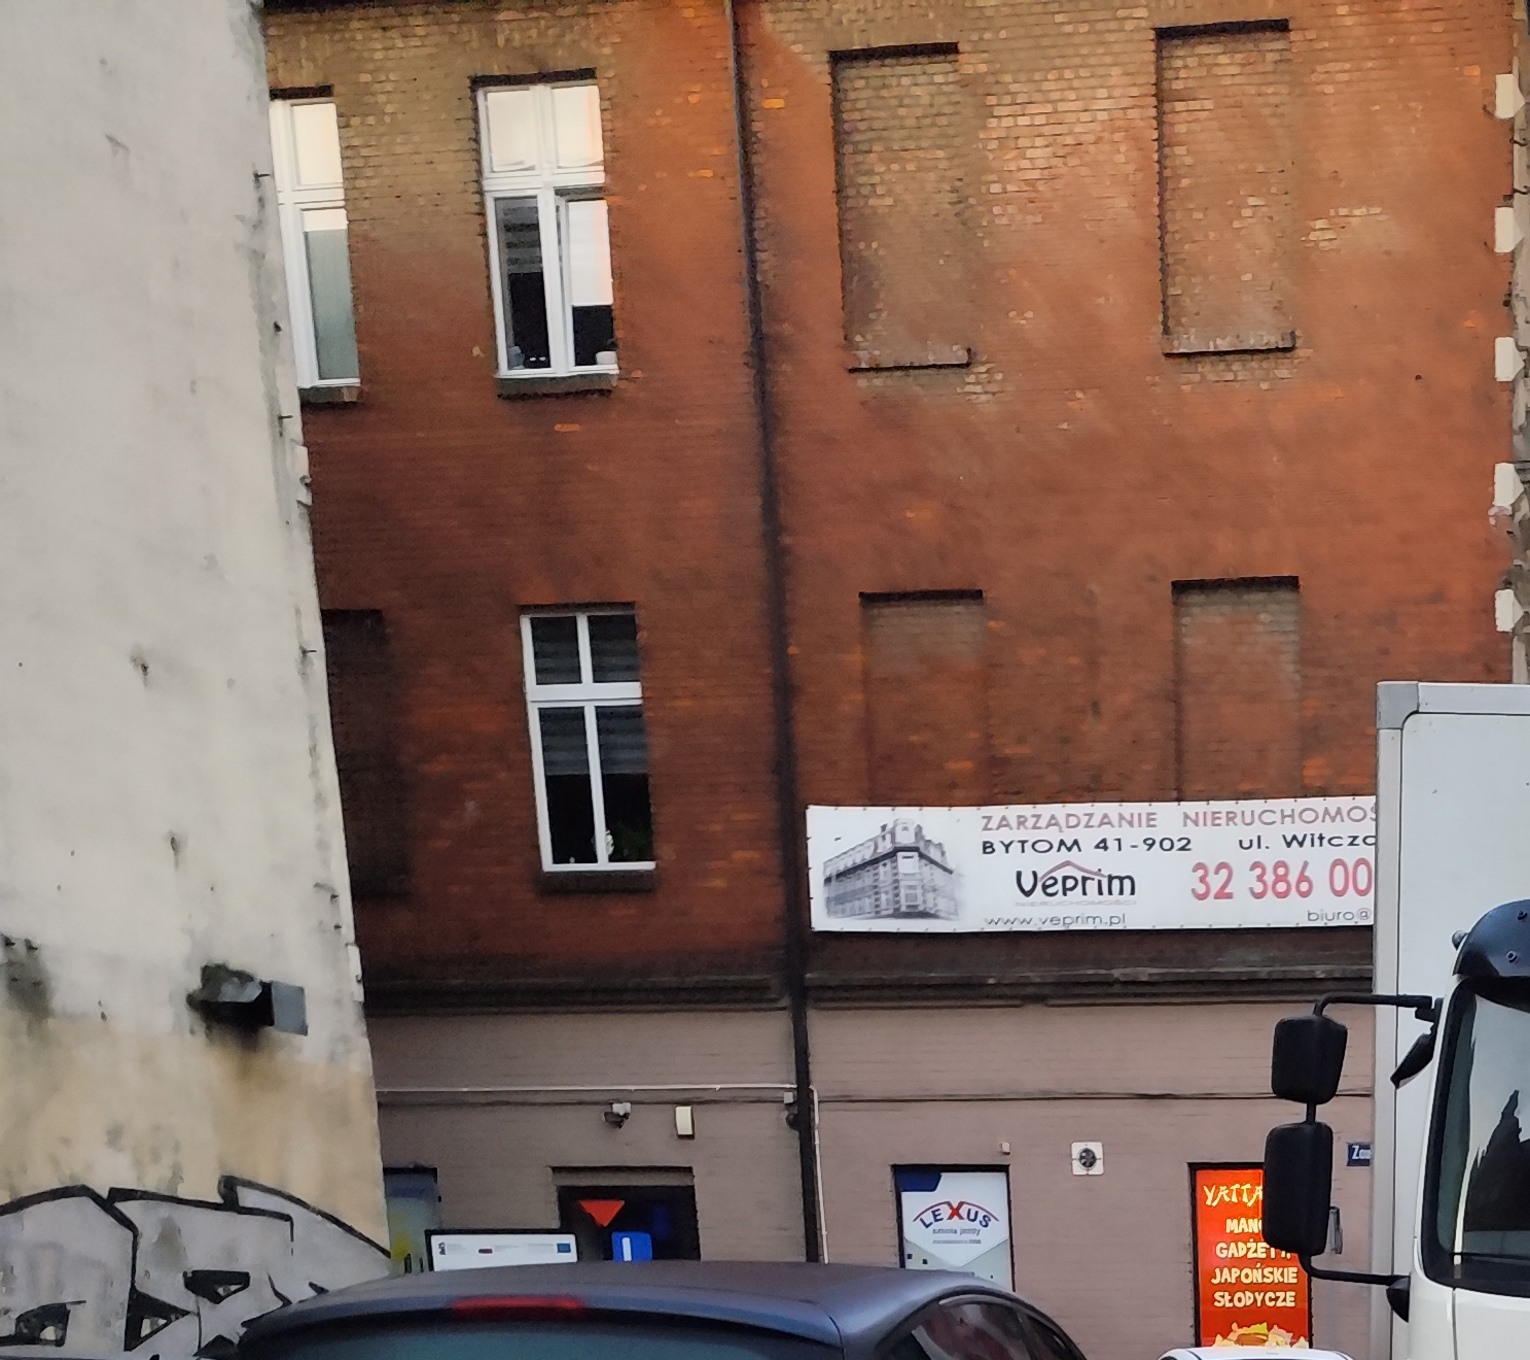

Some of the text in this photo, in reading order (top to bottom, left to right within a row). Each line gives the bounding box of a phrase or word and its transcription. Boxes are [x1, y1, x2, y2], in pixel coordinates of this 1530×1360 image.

[981, 811, 1158, 833] ZARZĄDZANIE
[981, 838, 1082, 855] BYTOM
[1094, 836, 1192, 852] 41-902
[1238, 835, 1270, 850] ul.
[1015, 868, 1136, 898] Veprim
[1190, 857, 1373, 901] 32 386 00
[984, 912, 1126, 927] www.veprim.pl
[1306, 907, 1372, 922] biuro@
[919, 1200, 992, 1229] LEXUS
[1210, 1262, 1299, 1285] JAPOŃSKIE
[1213, 1290, 1297, 1308] SŁODYCZE
